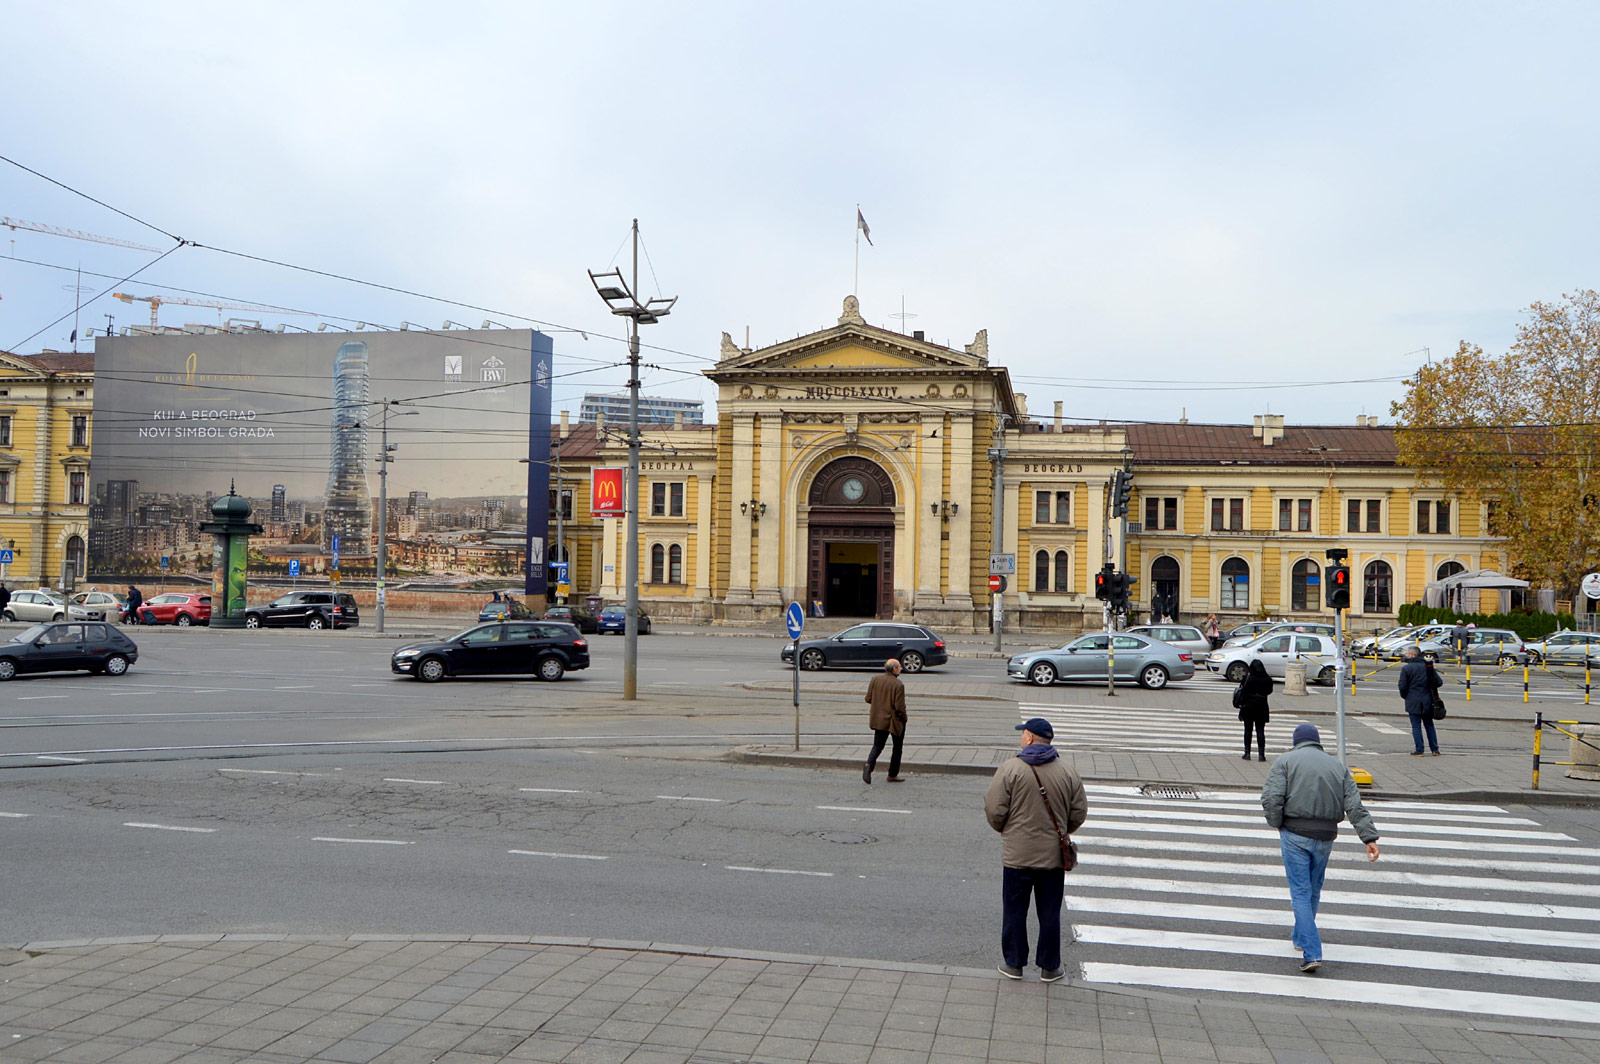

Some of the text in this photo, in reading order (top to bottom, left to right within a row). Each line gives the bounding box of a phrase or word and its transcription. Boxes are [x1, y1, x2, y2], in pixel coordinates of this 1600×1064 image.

[484, 369, 503, 382] BW
[806, 387, 897, 397] MDCCCLXXXIV
[153, 410, 256, 420] KULA BEOGRAD
[139, 427, 275, 438] NOVI SIMBOL GRADA
[641, 462, 693, 470] БЕОГРАД
[1024, 464, 1083, 473] BEOGRAD
[291, 560, 298, 569] P
[561, 568, 567, 578] P
